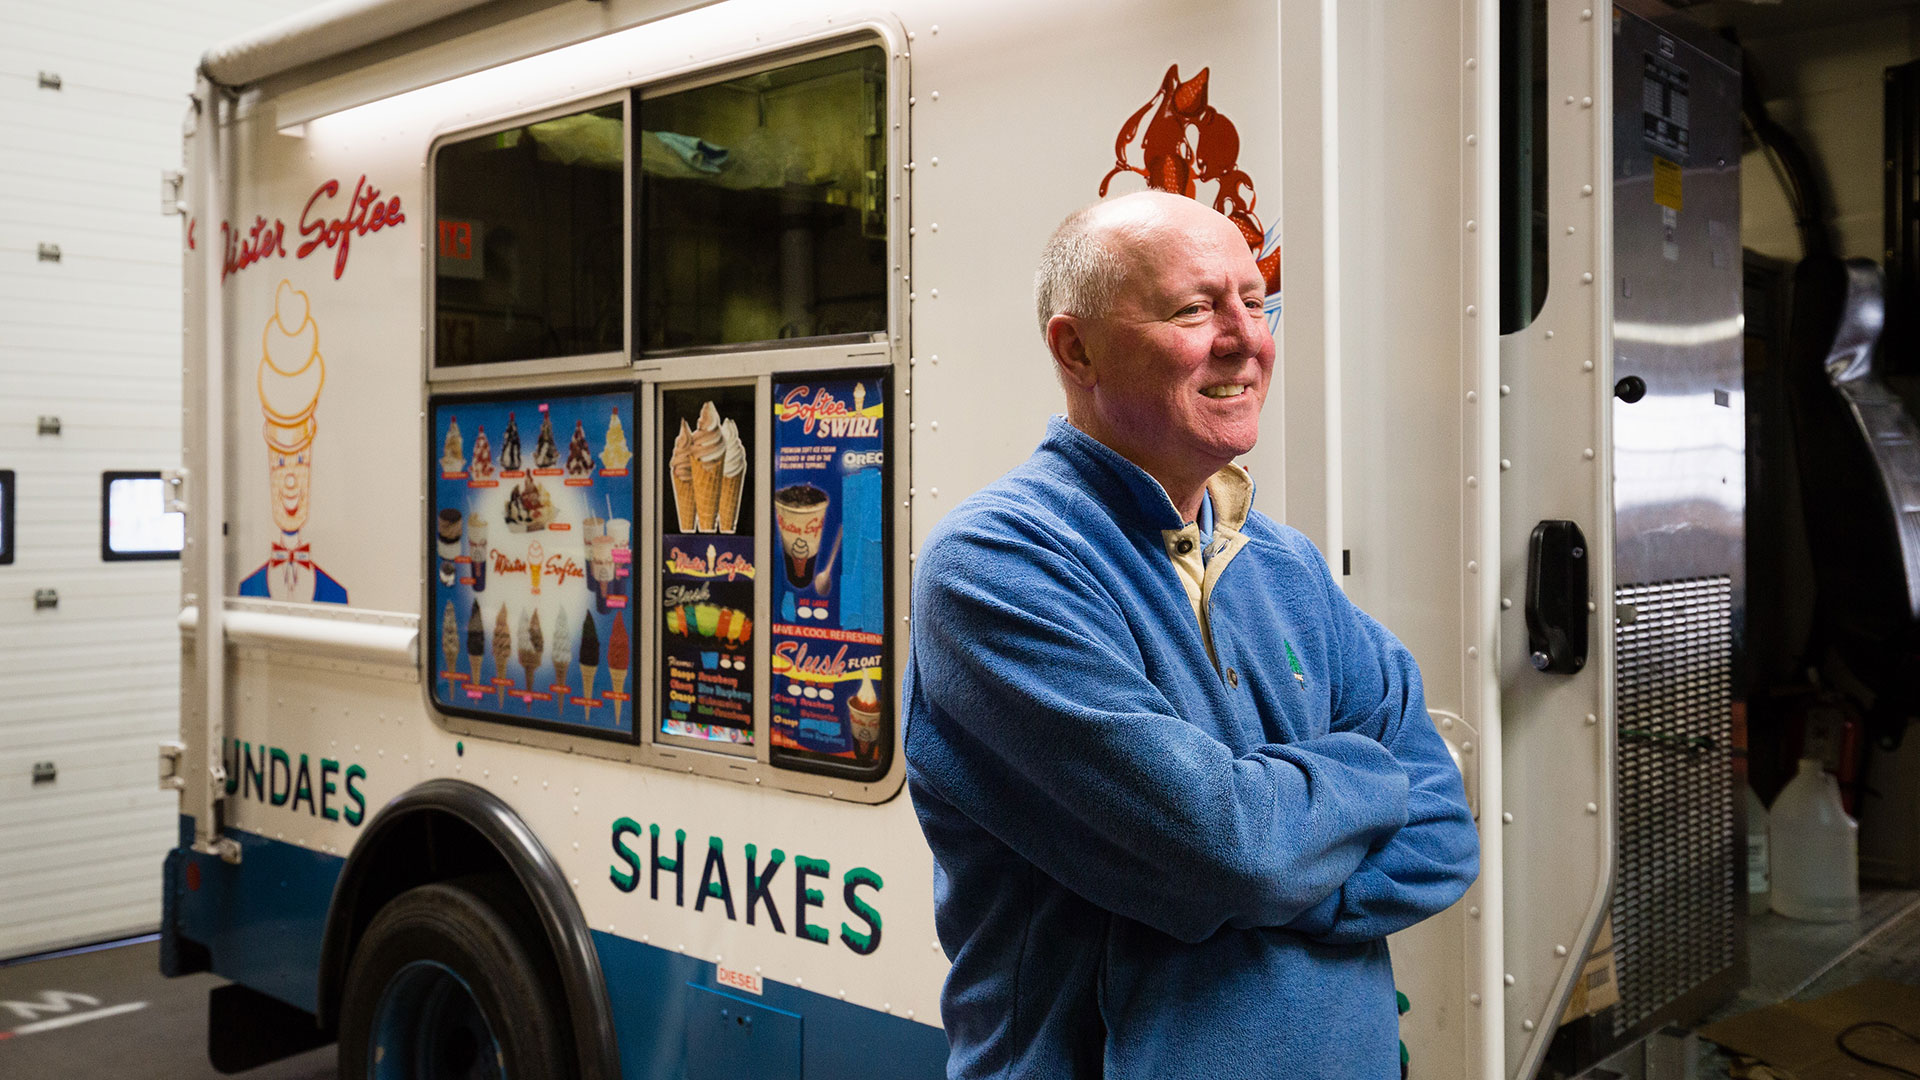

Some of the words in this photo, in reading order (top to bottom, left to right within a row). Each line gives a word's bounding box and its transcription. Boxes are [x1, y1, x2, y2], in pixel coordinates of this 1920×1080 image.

[297, 174, 405, 280] Softee
[779, 385, 847, 435] Softee
[816, 417, 879, 439] SWIRL
[795, 626, 802, 636] A
[802, 627, 827, 640] COOL
[773, 641, 848, 679] Slush
[847, 655, 882, 669] FLOAT
[223, 736, 368, 827] UNDAES
[609, 816, 884, 956] SHAKES
[719, 967, 759, 992] DIESEL
